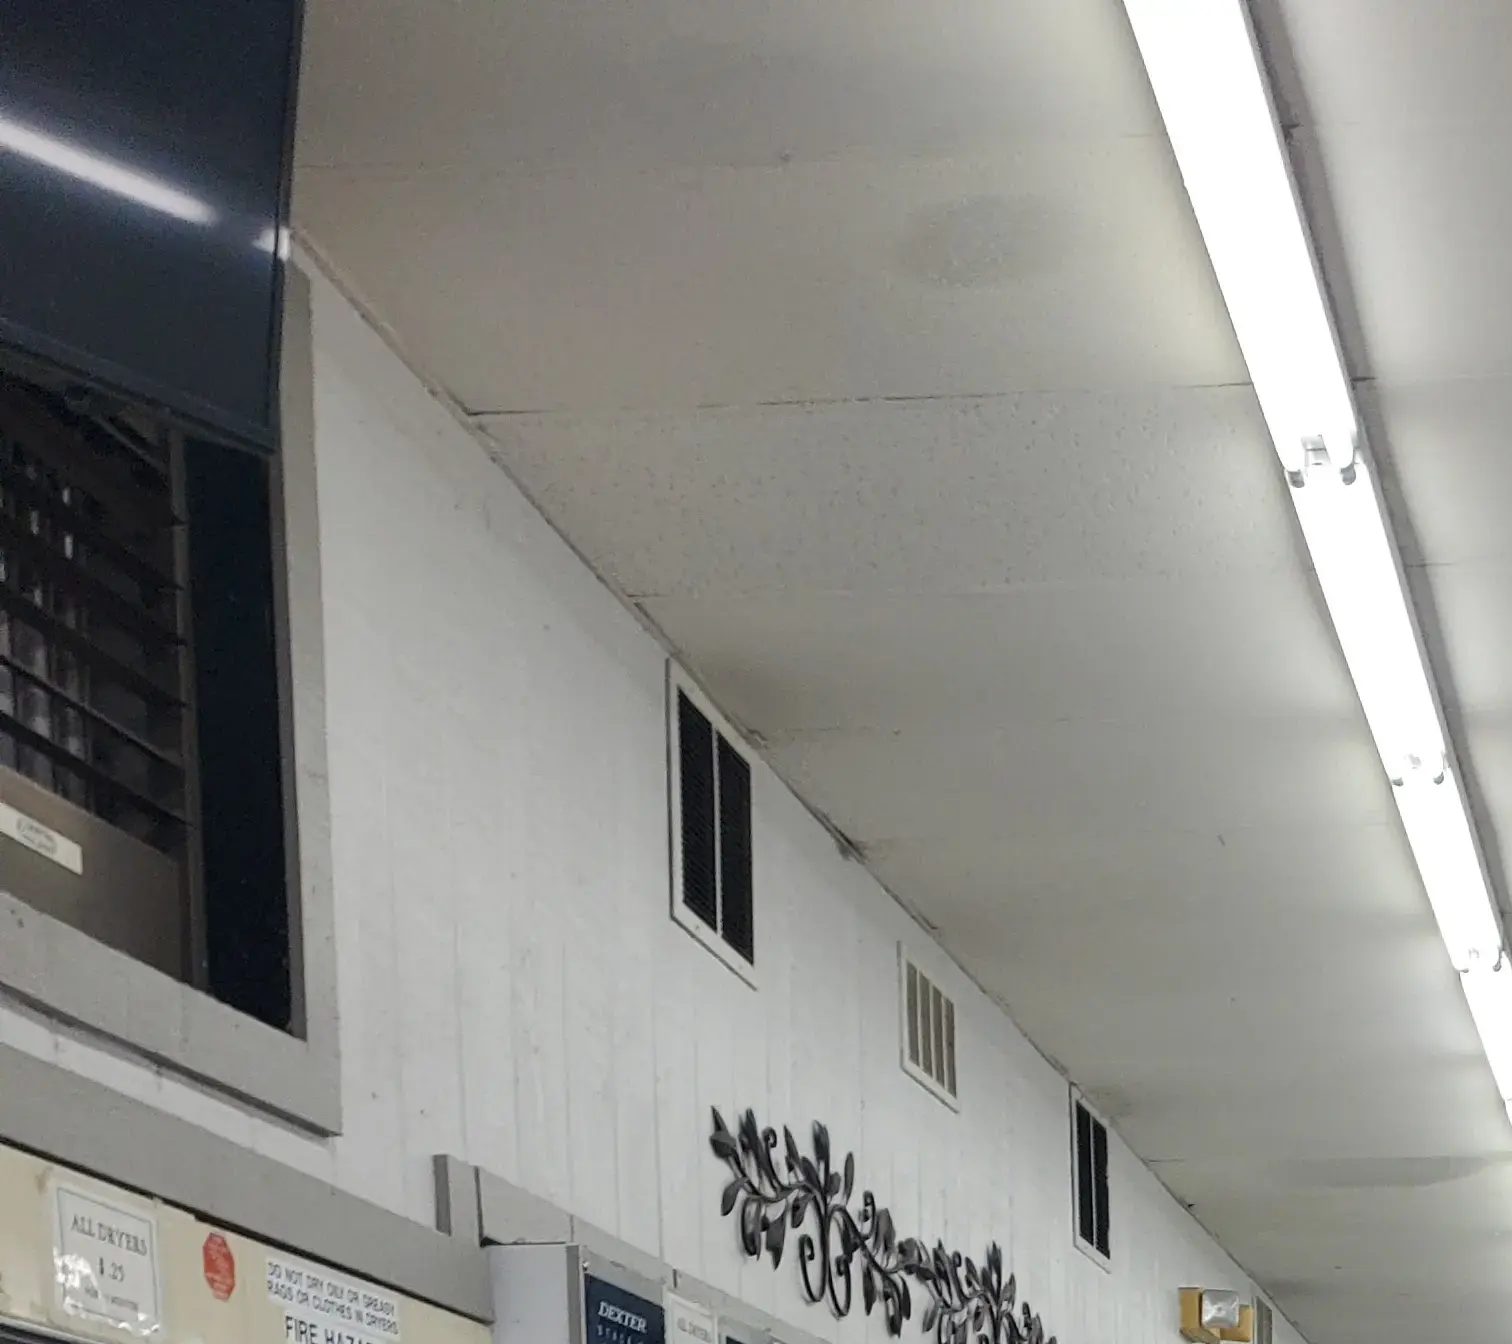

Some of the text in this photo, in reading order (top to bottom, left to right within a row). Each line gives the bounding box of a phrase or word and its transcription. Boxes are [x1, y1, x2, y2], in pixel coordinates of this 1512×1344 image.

[71, 1213, 148, 1257] ALL DRYERS
[285, 1267, 303, 1285] NOT
[306, 1274, 324, 1292] DRY
[312, 1294, 353, 1321] CLOTHES
[365, 1311, 399, 1336] DRYERS
[597, 1300, 648, 1334] DEXTER
